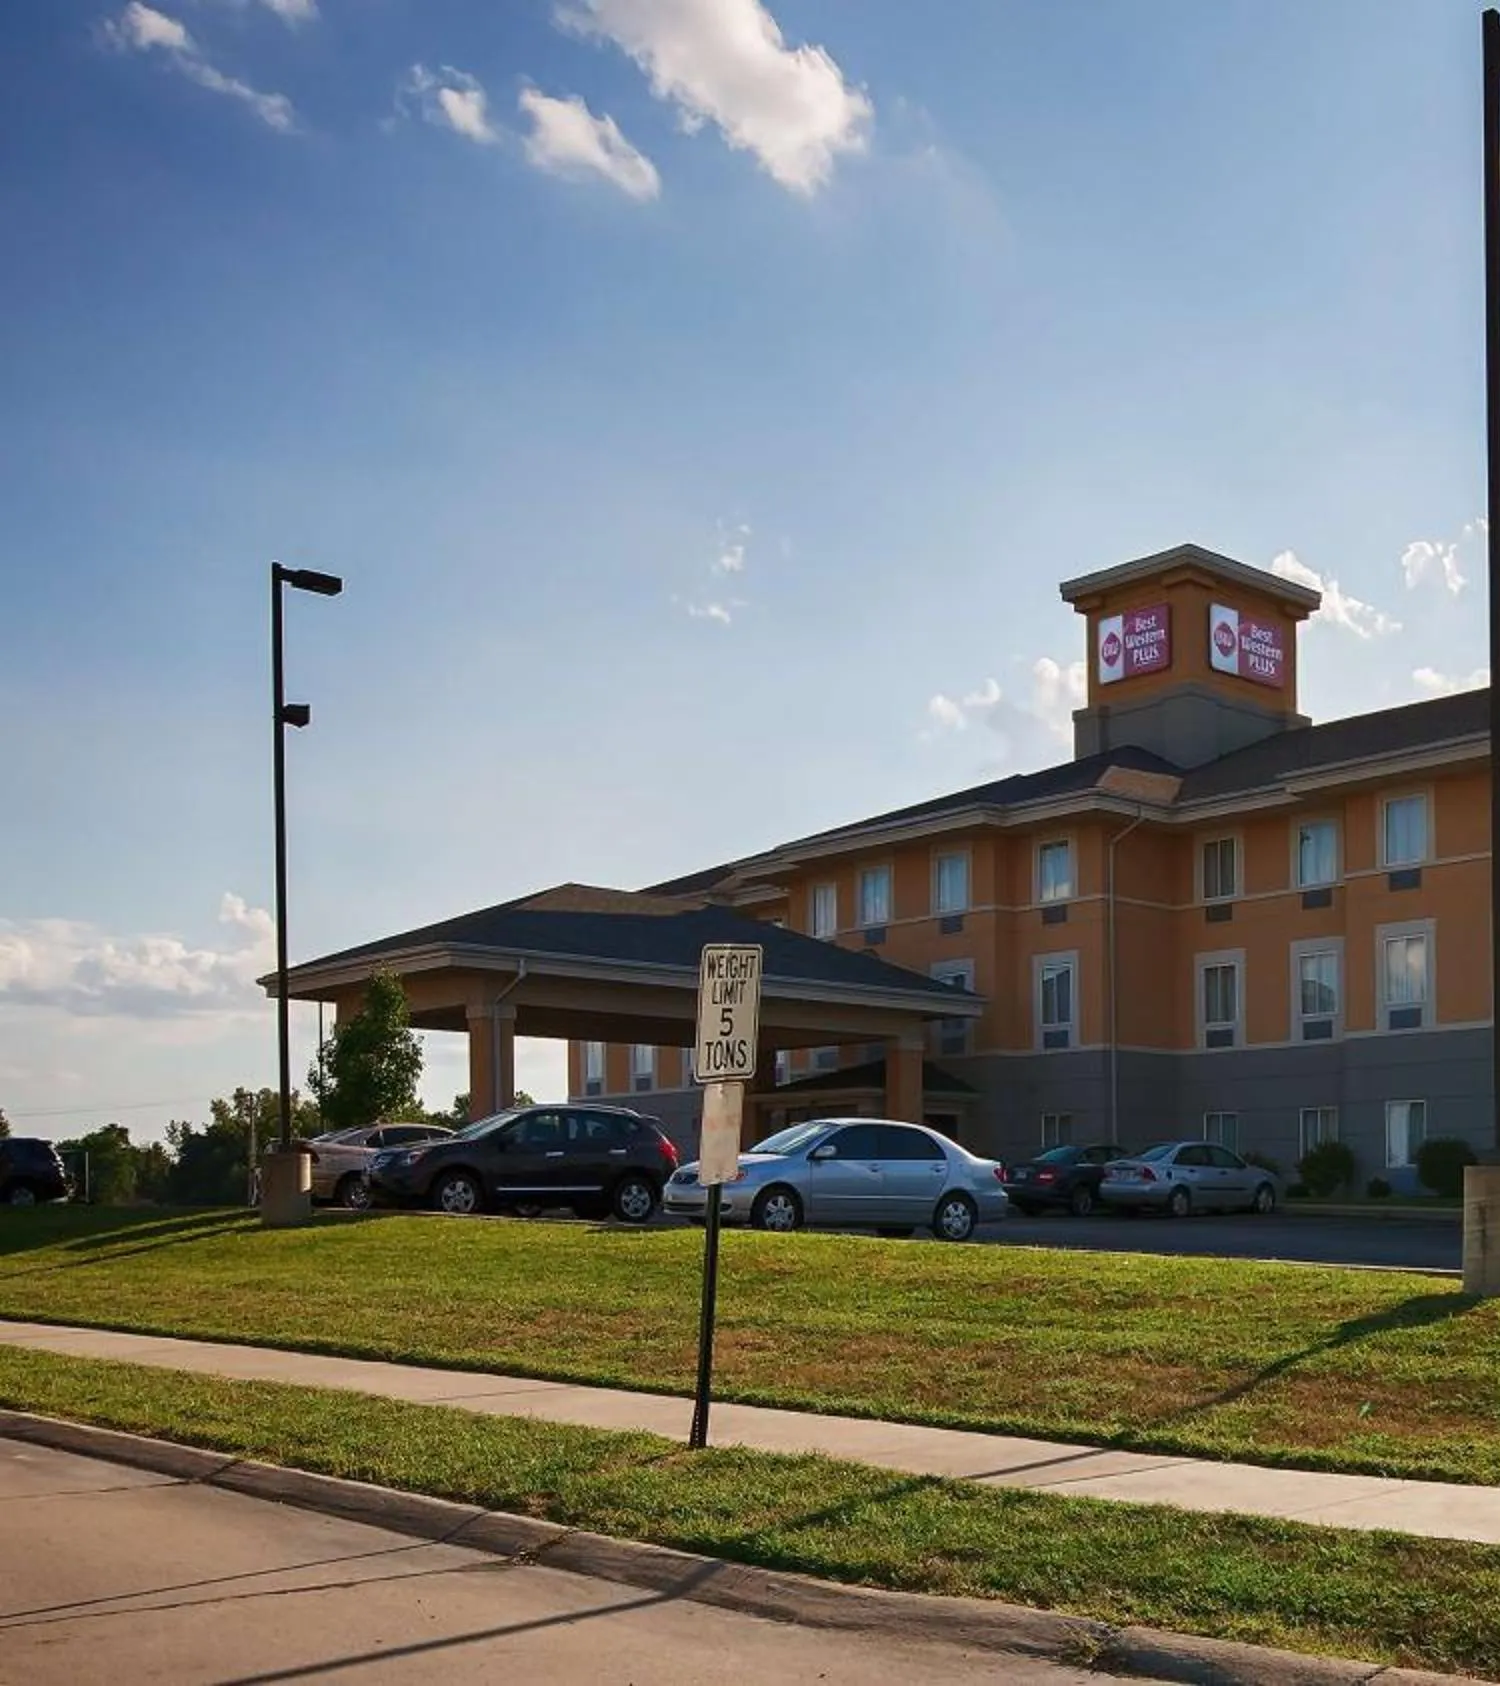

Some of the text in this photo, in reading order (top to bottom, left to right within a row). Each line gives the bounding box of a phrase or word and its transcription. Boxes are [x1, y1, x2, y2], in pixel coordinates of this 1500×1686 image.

[1135, 615, 1157, 632] Best
[1251, 624, 1273, 643] Best
[1126, 629, 1165, 648] Western
[1241, 636, 1283, 662] Western
[1133, 646, 1158, 664] PLUS
[1249, 655, 1276, 674] PLUS
[707, 955, 756, 979] WEIGHT
[712, 980, 746, 1004] LIMIT
[719, 1008, 734, 1037] 5
[705, 1040, 747, 1071] TONS
